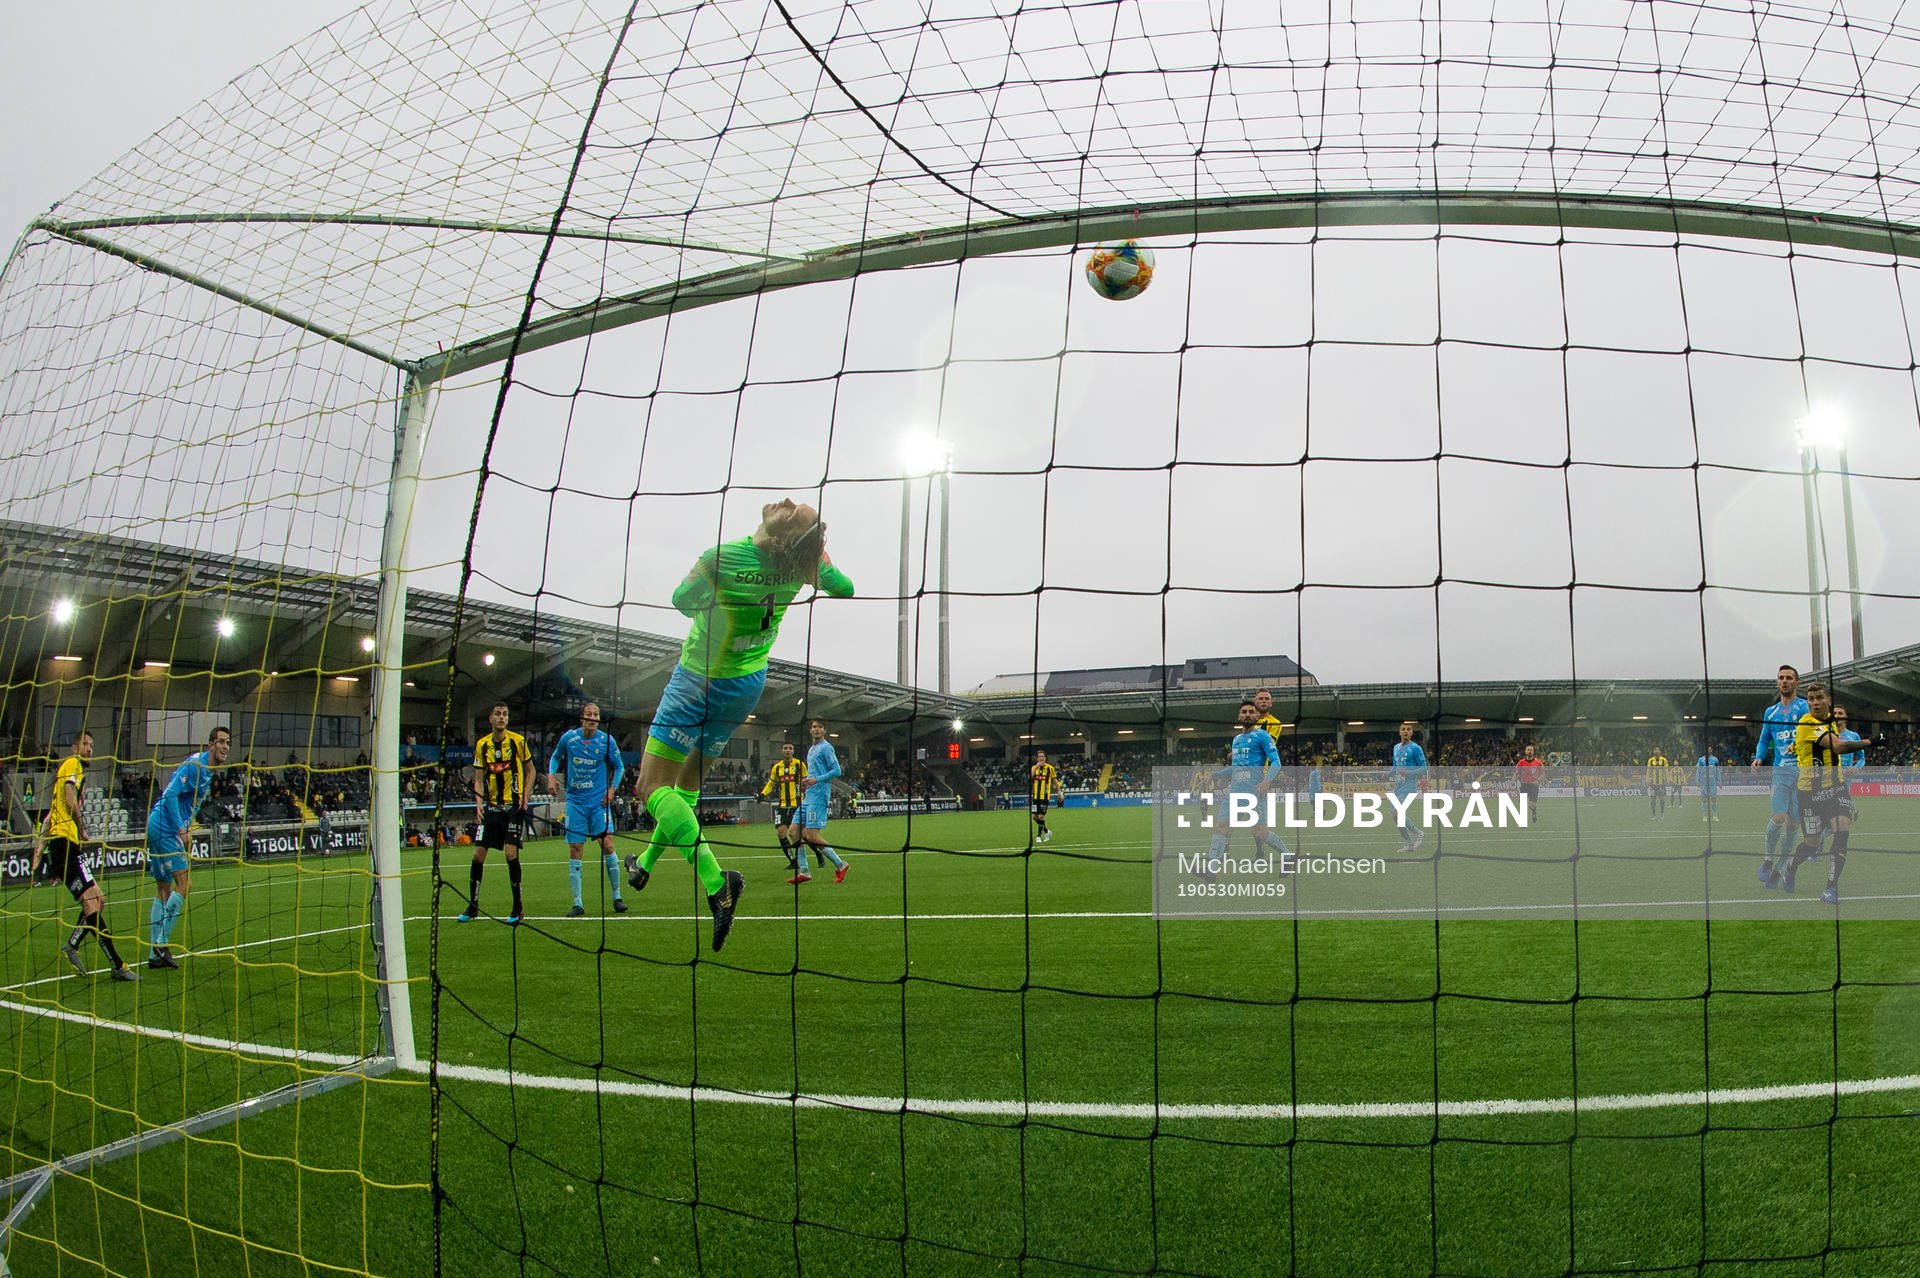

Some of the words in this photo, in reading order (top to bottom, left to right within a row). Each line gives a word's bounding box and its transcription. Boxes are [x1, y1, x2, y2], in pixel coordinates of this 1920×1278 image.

[760, 593, 775, 631] 1
[1590, 787, 1642, 797] Caverion
[190, 839, 209, 859] ÄR
